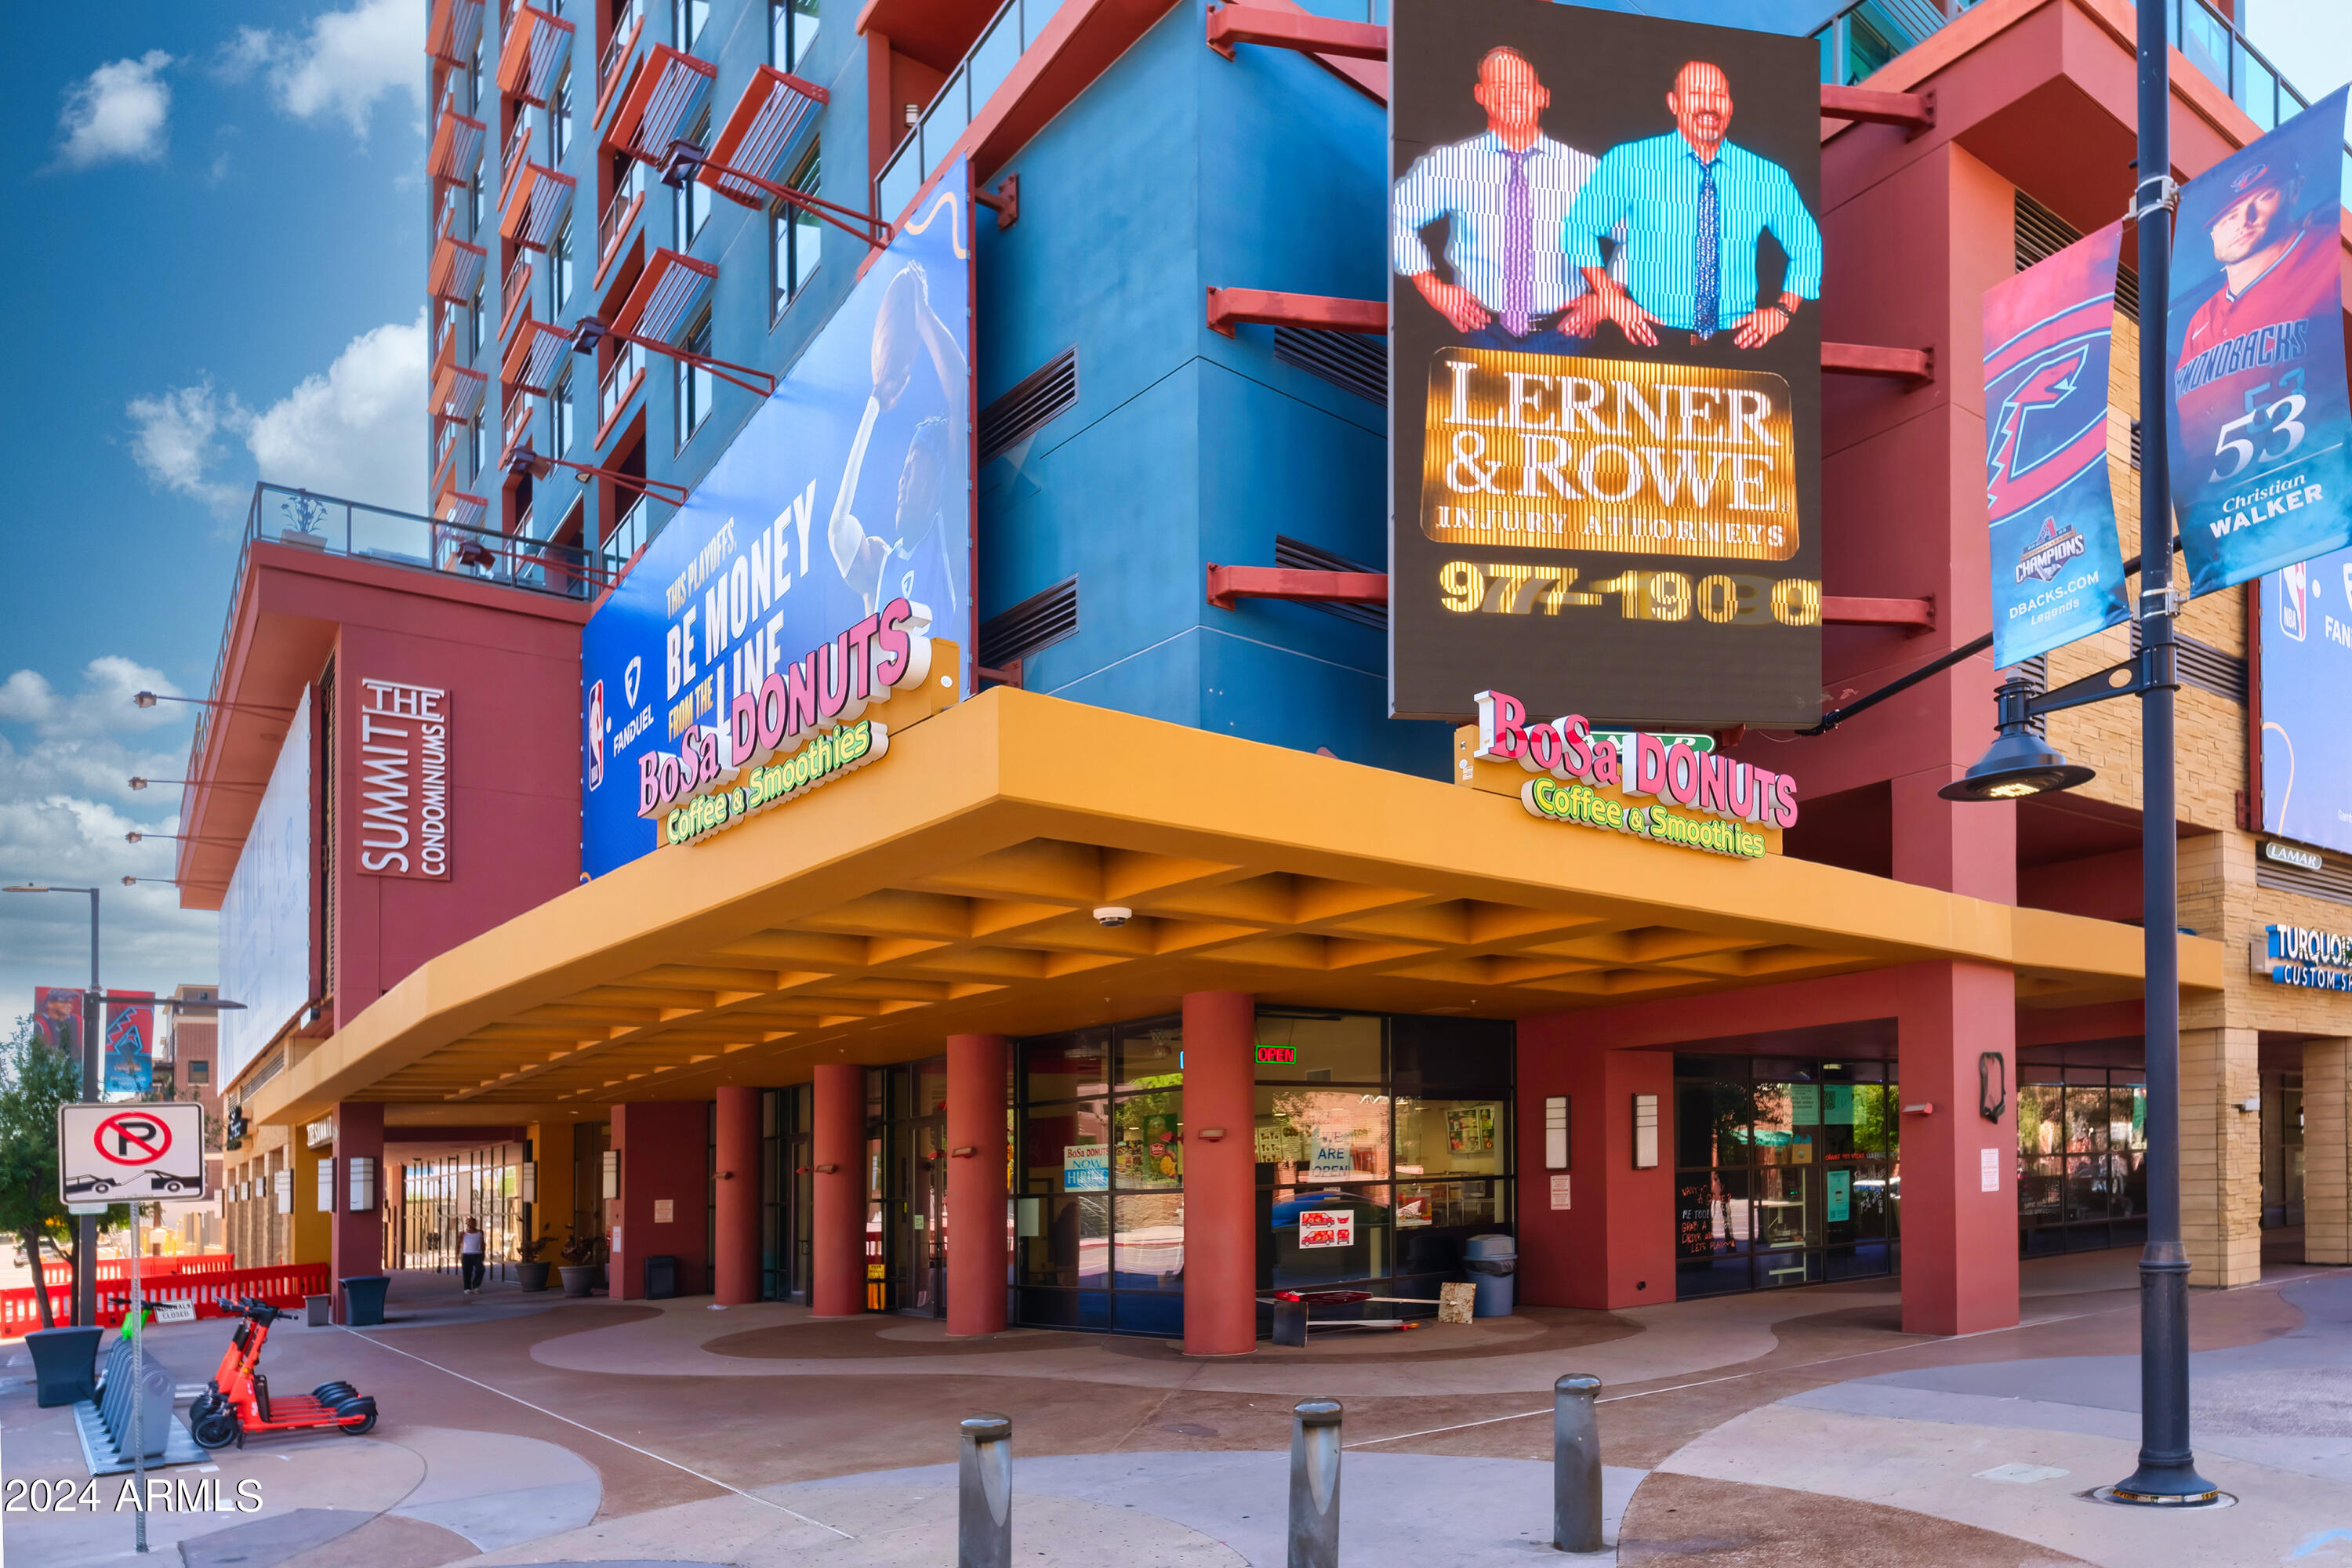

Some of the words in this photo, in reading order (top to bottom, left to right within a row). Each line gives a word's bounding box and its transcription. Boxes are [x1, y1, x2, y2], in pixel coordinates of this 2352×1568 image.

[1443, 361, 1783, 448] LERNER
[2208, 394, 2307, 483] 53
[1446, 430, 1505, 494] &
[1513, 433, 1777, 512] ROWE
[2222, 474, 2307, 514] Christian
[1436, 506, 1566, 535] INJURY
[1584, 514, 1784, 547] ATTORNEYS
[2209, 483, 2324, 539] WALKER
[2016, 533, 2085, 584] CHAMPIONS
[666, 604, 696, 702] BE
[706, 477, 817, 668] MONEY
[666, 572, 687, 619] THIS
[2009, 571, 2100, 619] DBACKS.COM
[2031, 598, 2080, 626] Legends
[2284, 605, 2296, 631] NBA
[366, 684, 441, 719] THE
[638, 724, 721, 818] BoSa
[731, 597, 913, 767] DONUTS
[669, 691, 694, 743] FROM
[695, 673, 713, 720] THE
[614, 704, 654, 757] FANDUEL
[666, 793, 729, 844] Coffee
[731, 789, 745, 814] &
[748, 720, 872, 804] Smoothies
[1486, 689, 1621, 784] BoSa
[1635, 732, 1798, 829] DONUTS
[361, 714, 409, 873] SUMMIT
[421, 723, 446, 876] CONDOMINIUMS
[1533, 777, 1624, 829] Coffee
[1627, 807, 1646, 833] &
[1649, 804, 1766, 858] Smoothies
[2271, 845, 2318, 866] LAMAR
[2284, 964, 2336, 989] CUSTOM
[1258, 1047, 1294, 1062] OPEN
[1067, 1147, 1085, 1158] BoSa
[1087, 1146, 1109, 1157] DONUTS
[1073, 1159, 1102, 1168] NOW
[1312, 1165, 1348, 1177] OPEN
[1317, 1148, 1345, 1160] ARE
[1694, 1209, 1710, 1219] TOO!
[1702, 1220, 1708, 1230] A
[162, 1310, 190, 1319] CLOSED
